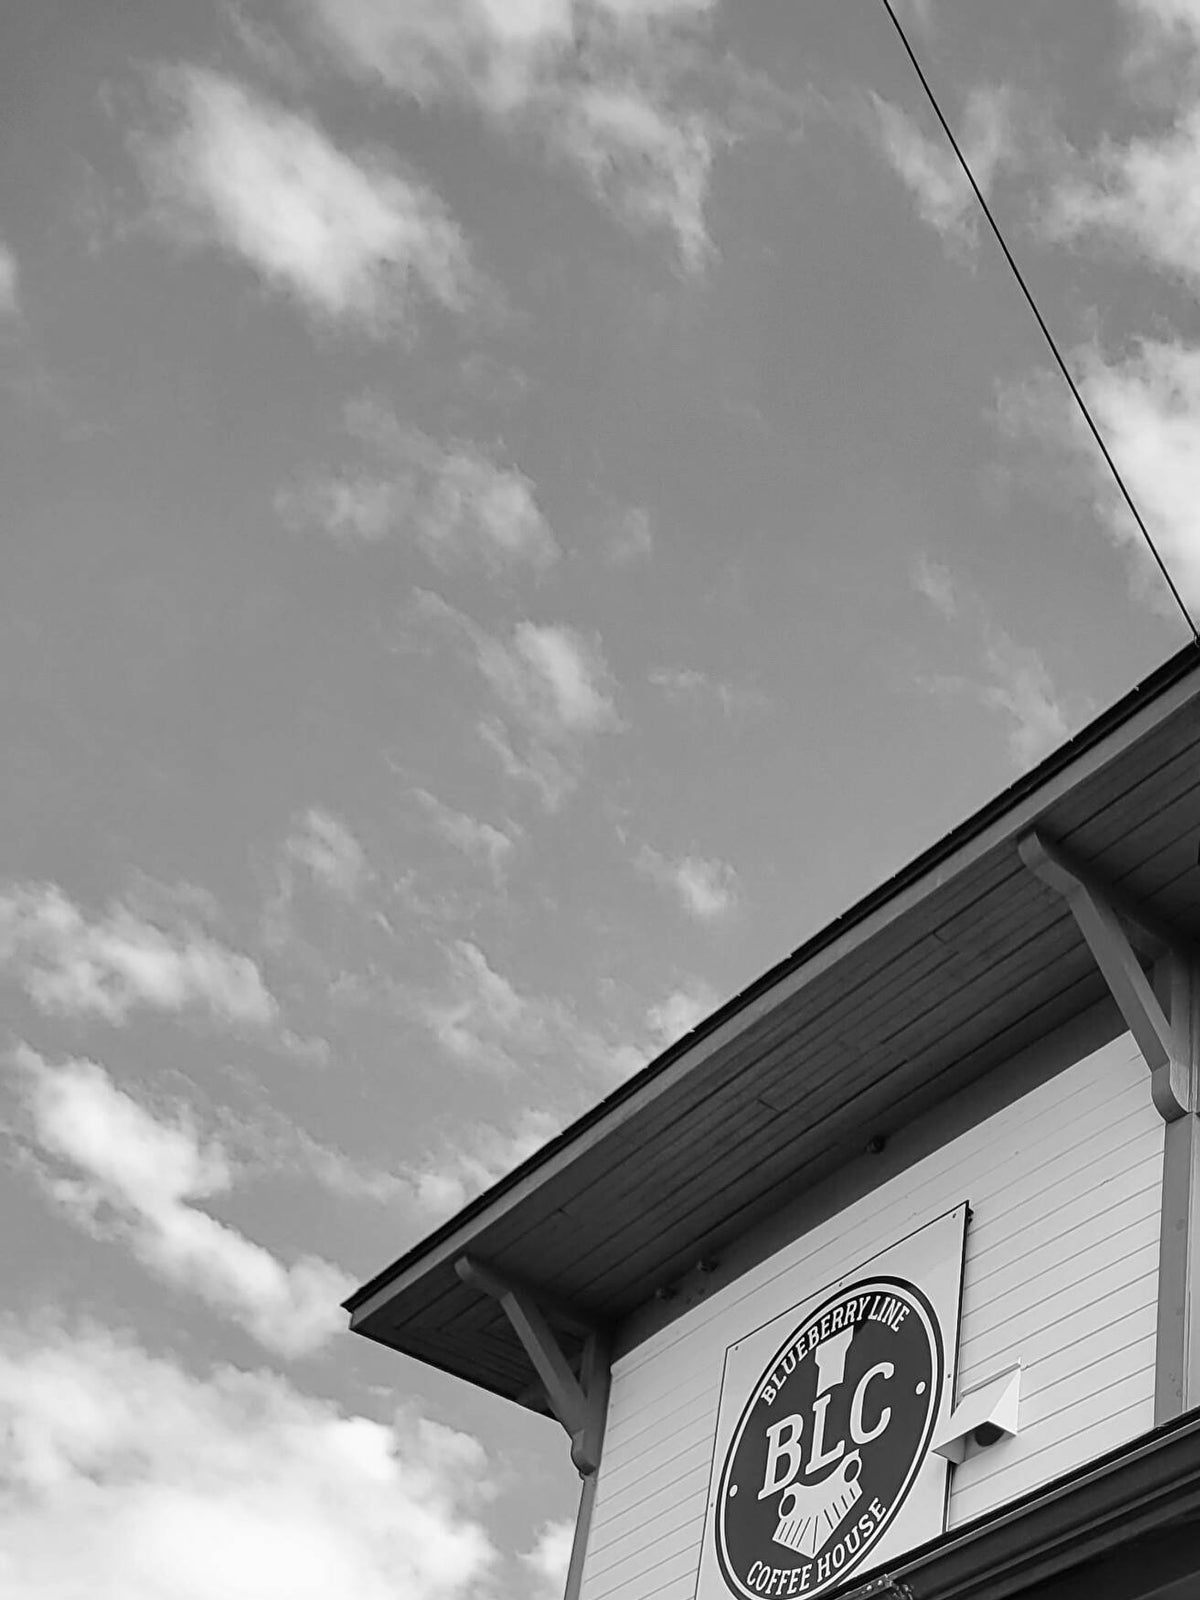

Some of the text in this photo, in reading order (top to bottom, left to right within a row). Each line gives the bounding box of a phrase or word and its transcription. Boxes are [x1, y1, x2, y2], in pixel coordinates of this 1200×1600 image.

[761, 1295, 910, 1406] BLUEBERRY LINE
[757, 1362, 894, 1500] BLC
[747, 1498, 886, 1595] COFFEE HOUSE
